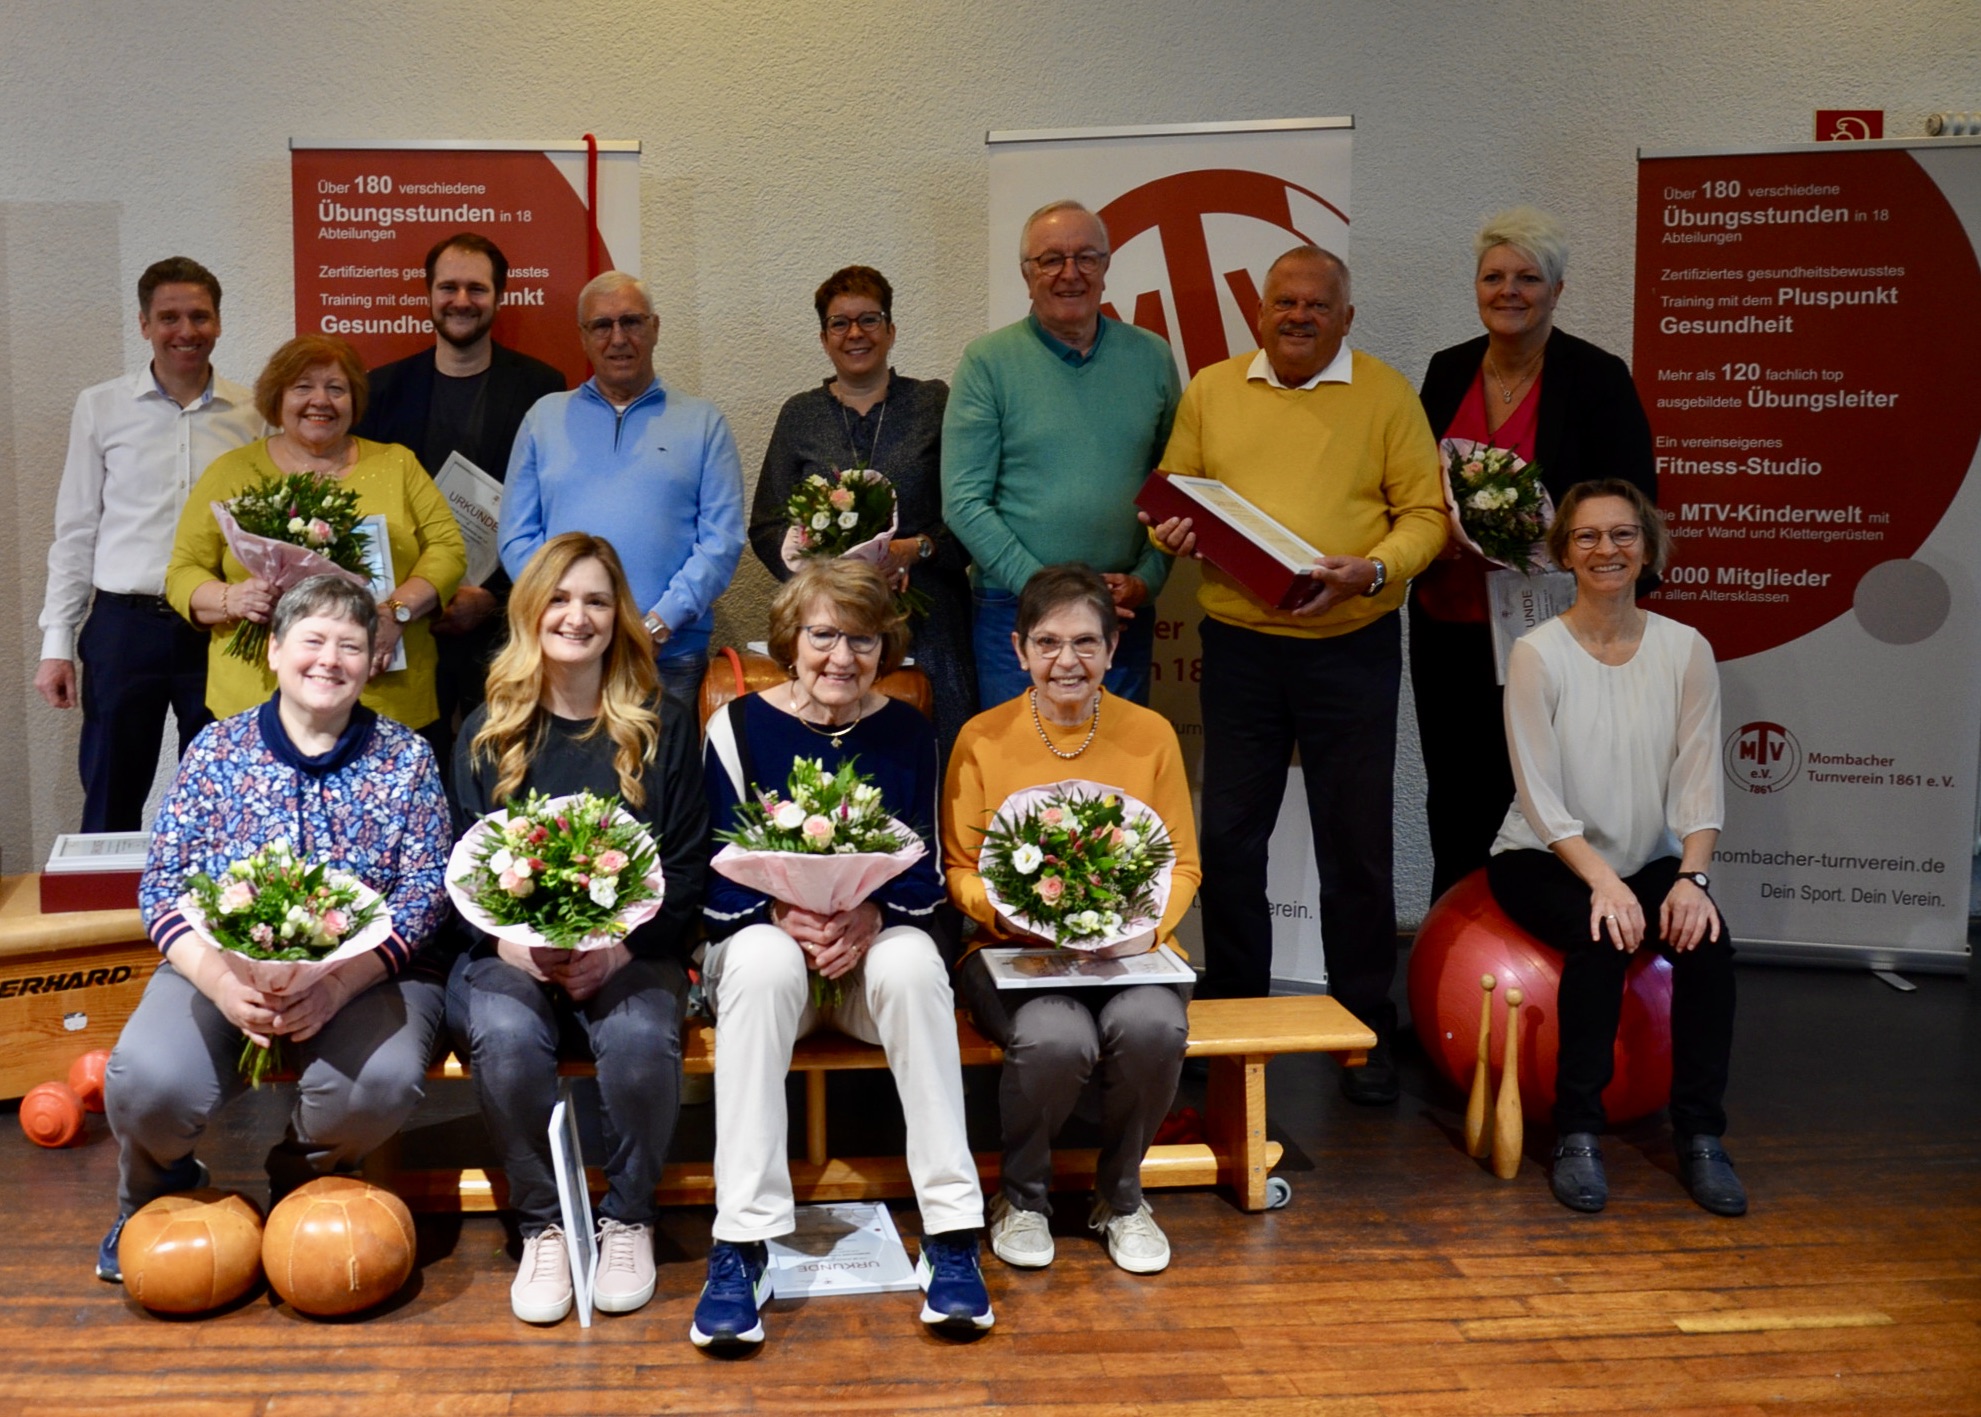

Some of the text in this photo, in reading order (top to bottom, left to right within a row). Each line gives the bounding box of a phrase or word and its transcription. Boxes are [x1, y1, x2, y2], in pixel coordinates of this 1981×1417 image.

[318, 175, 486, 195] Über 180 verschiedene
[1664, 180, 1840, 200] Über 180 verschiedene
[318, 199, 532, 226] Übungsstunden in 18
[1663, 205, 1889, 230] Übungsstunden in 18
[318, 227, 396, 242] Abteilungen
[1662, 231, 1742, 245] Abteilungen
[319, 265, 399, 278] Zertifiziertes
[1661, 265, 1905, 282] Zertifiziertes gesundheitsbewusstes
[320, 293, 428, 308] Training mit dem
[1661, 287, 1899, 309] Training mit dem Pluspunkt
[320, 315, 436, 334] Gesundhe
[1660, 316, 1794, 334] Gesundheit
[1658, 363, 1844, 383] Mehr als 120 fachlich top
[1657, 386, 1899, 412] ausgebildete Übungsleiter
[1656, 436, 1783, 450] Ein vereinseigenes
[1655, 457, 1822, 476] Fitness-Studio
[1680, 503, 1863, 523] MTV-Kinderwelt
[1868, 512, 1890, 524] mit
[1665, 526, 1884, 542] oulder Wand und Klettergerüsten
[1717, 567, 1832, 589] Mitglieder
[1665, 589, 1697, 600] allen
[1700, 590, 1789, 602] Altersklassen
[1740, 721, 1786, 765] MTV
[1808, 752, 1895, 767] Mombacher
[1808, 770, 1955, 788] Turnverein 1861 e. V.
[1749, 784, 1773, 794] 1861
[1761, 883, 1946, 908] Dein Sport. Dein Verein.
[1268, 900, 1313, 919] erein.
[0, 966, 132, 999] ERHARD
[799, 1261, 880, 1272] URKUNDE
